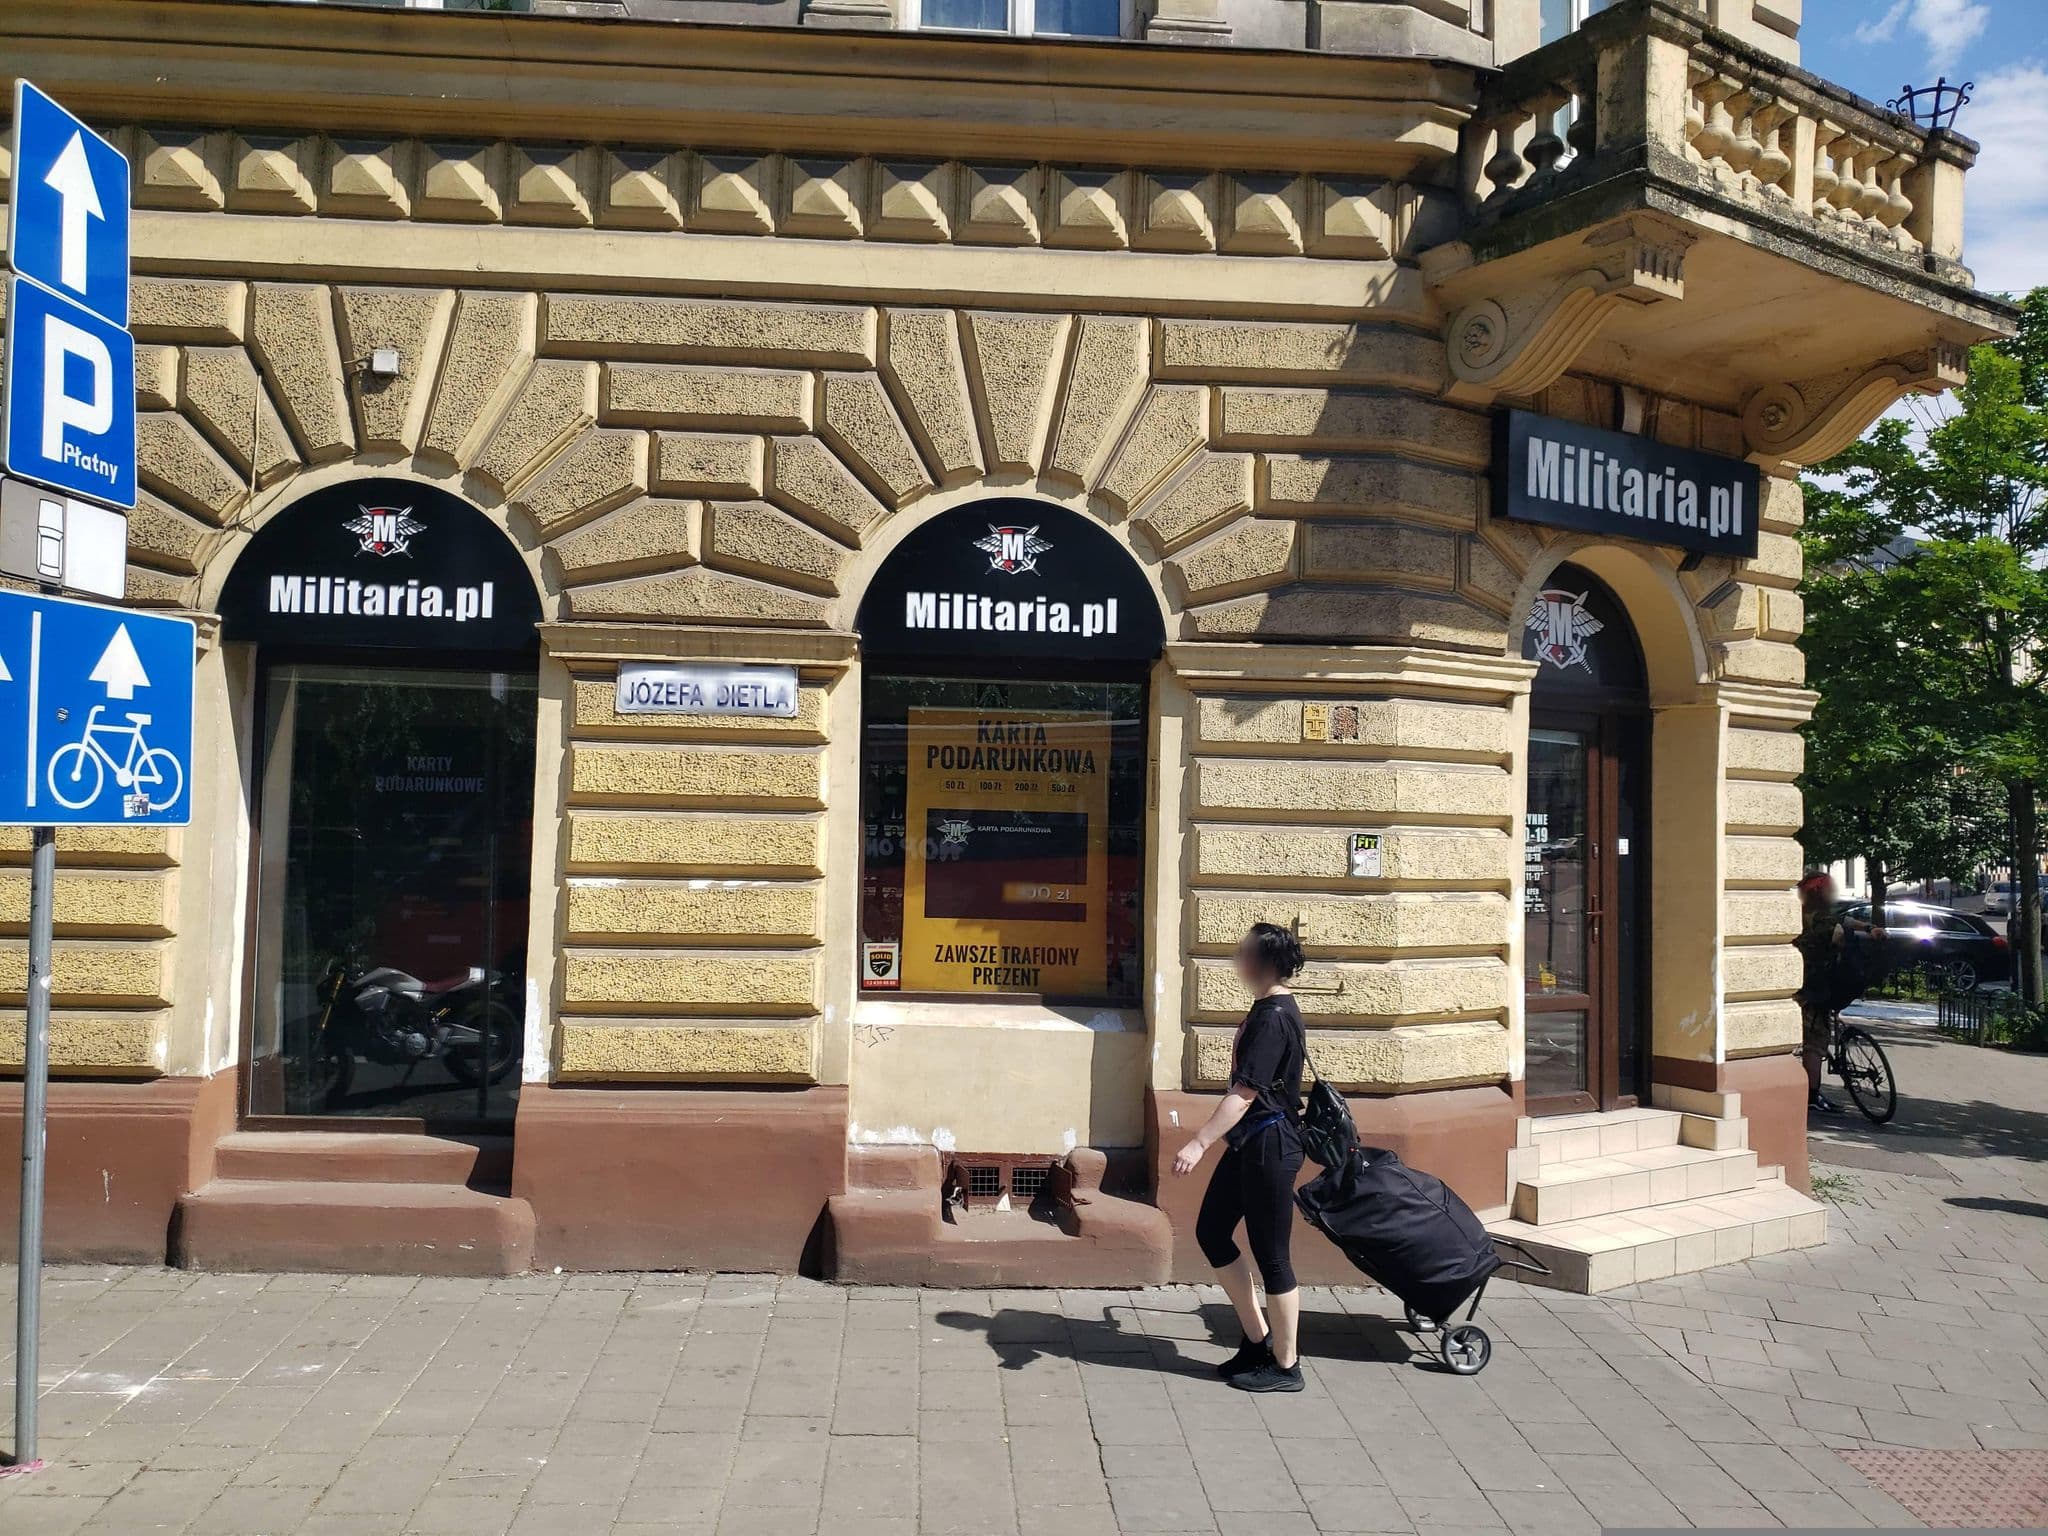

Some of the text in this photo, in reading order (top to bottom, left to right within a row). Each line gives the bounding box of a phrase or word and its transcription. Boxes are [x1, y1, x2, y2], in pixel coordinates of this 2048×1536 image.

[42, 313, 113, 462] P
[64, 441, 118, 484] Płatny
[1527, 436, 1743, 538] Militaria.pl
[372, 515, 396, 543] M
[1001, 533, 1024, 560] M
[269, 575, 494, 621] Militaria.pl
[905, 592, 1118, 637] Militaria.pl
[1549, 601, 1573, 646] M
[627, 677, 789, 708] JÓZEFA DIETLA
[976, 720, 1047, 746] KARTA
[407, 756, 453, 773] KARTY
[927, 745, 1096, 774] PODARUNKOWA
[375, 775, 485, 793] PODARUNKOWE
[945, 780, 955, 790] 50
[980, 781, 993, 791] 100
[1015, 782, 1029, 792] 200
[978, 825, 1052, 834] KARTA PODARUNKOWA
[1357, 837, 1377, 849] FIT
[934, 944, 1080, 966] ZAWSZE TRAFIONY
[972, 967, 1041, 987] PREZENT
